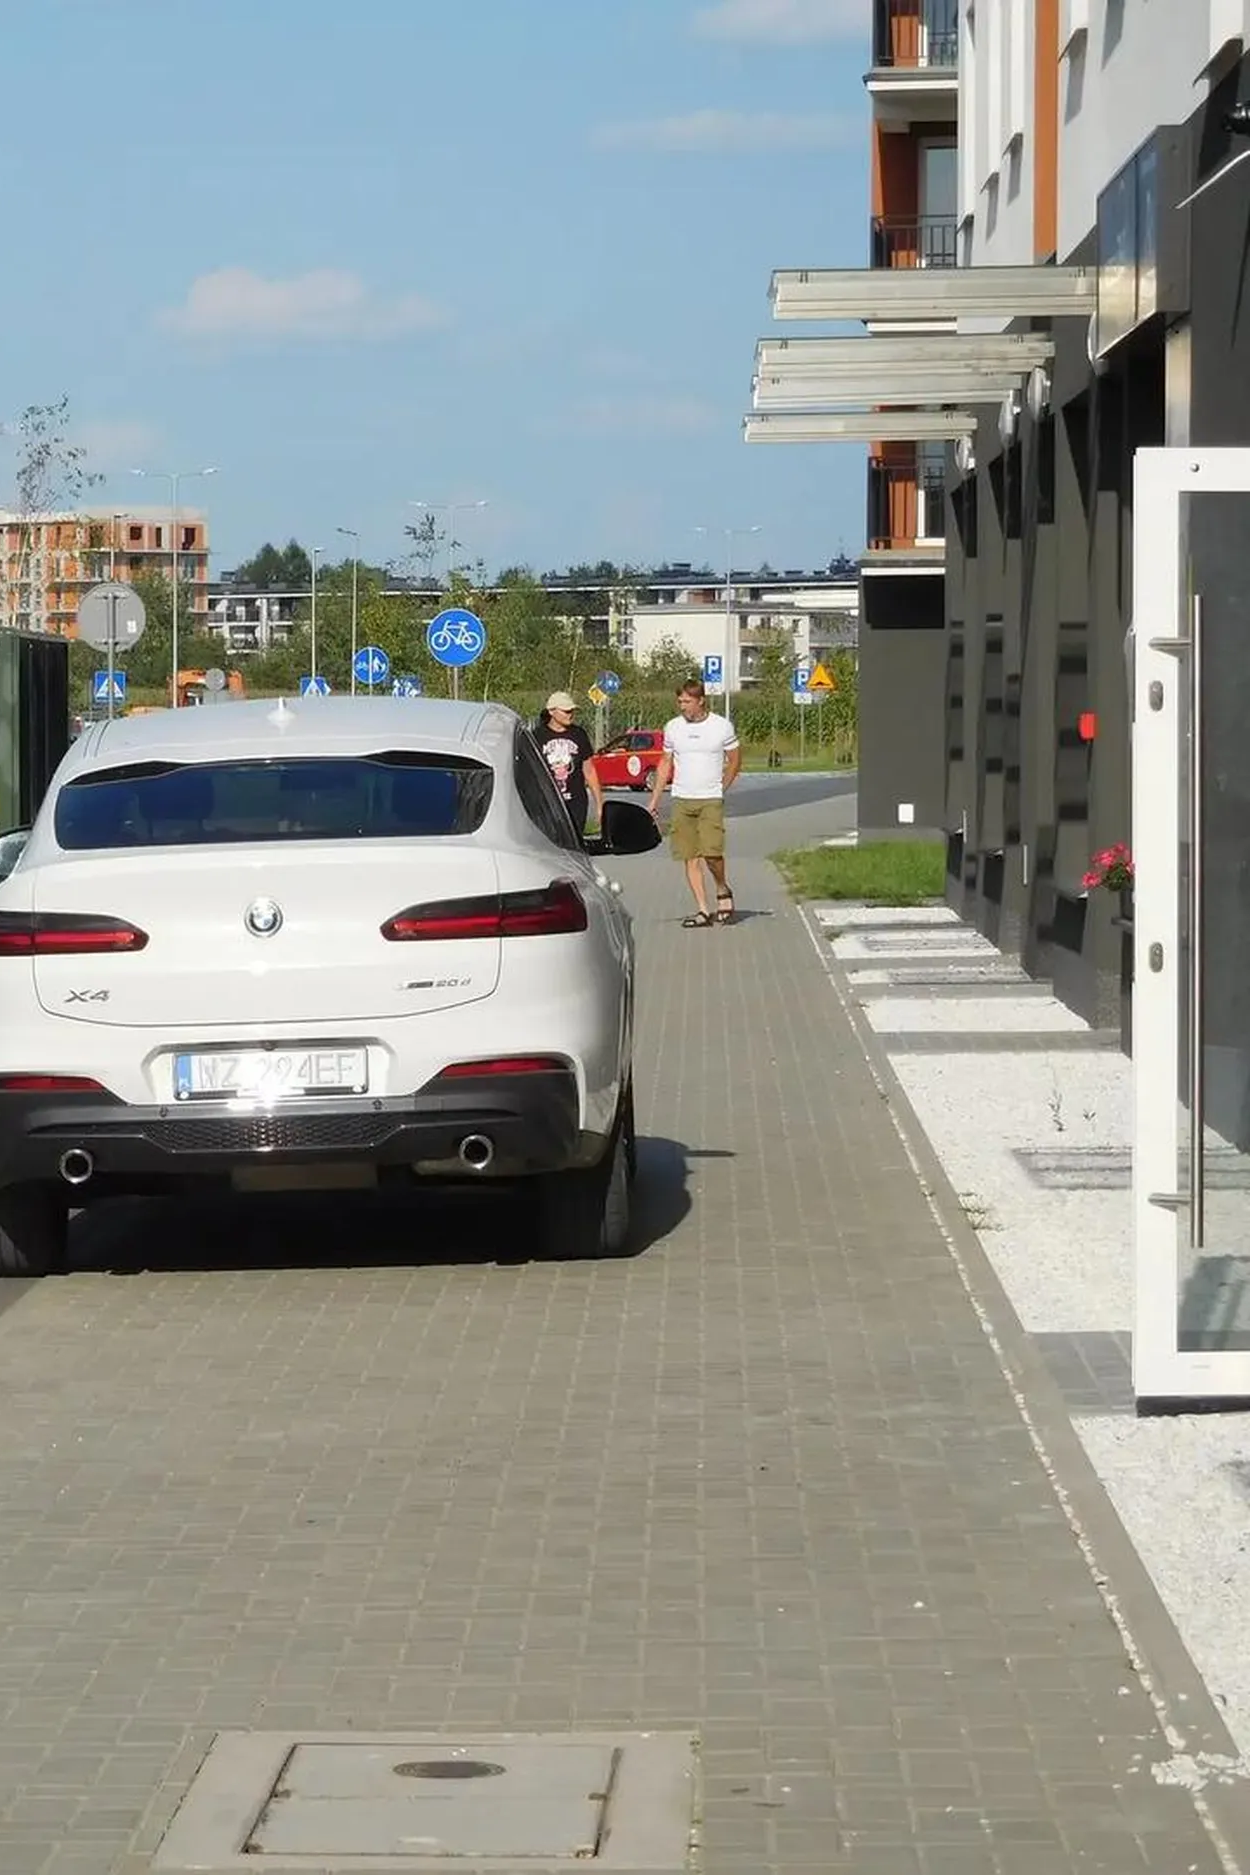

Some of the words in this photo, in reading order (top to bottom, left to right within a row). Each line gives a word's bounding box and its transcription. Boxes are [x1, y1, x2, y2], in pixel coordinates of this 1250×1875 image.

[707, 657, 720, 675] P
[797, 670, 809, 686] P
[63, 989, 111, 1002] X4
